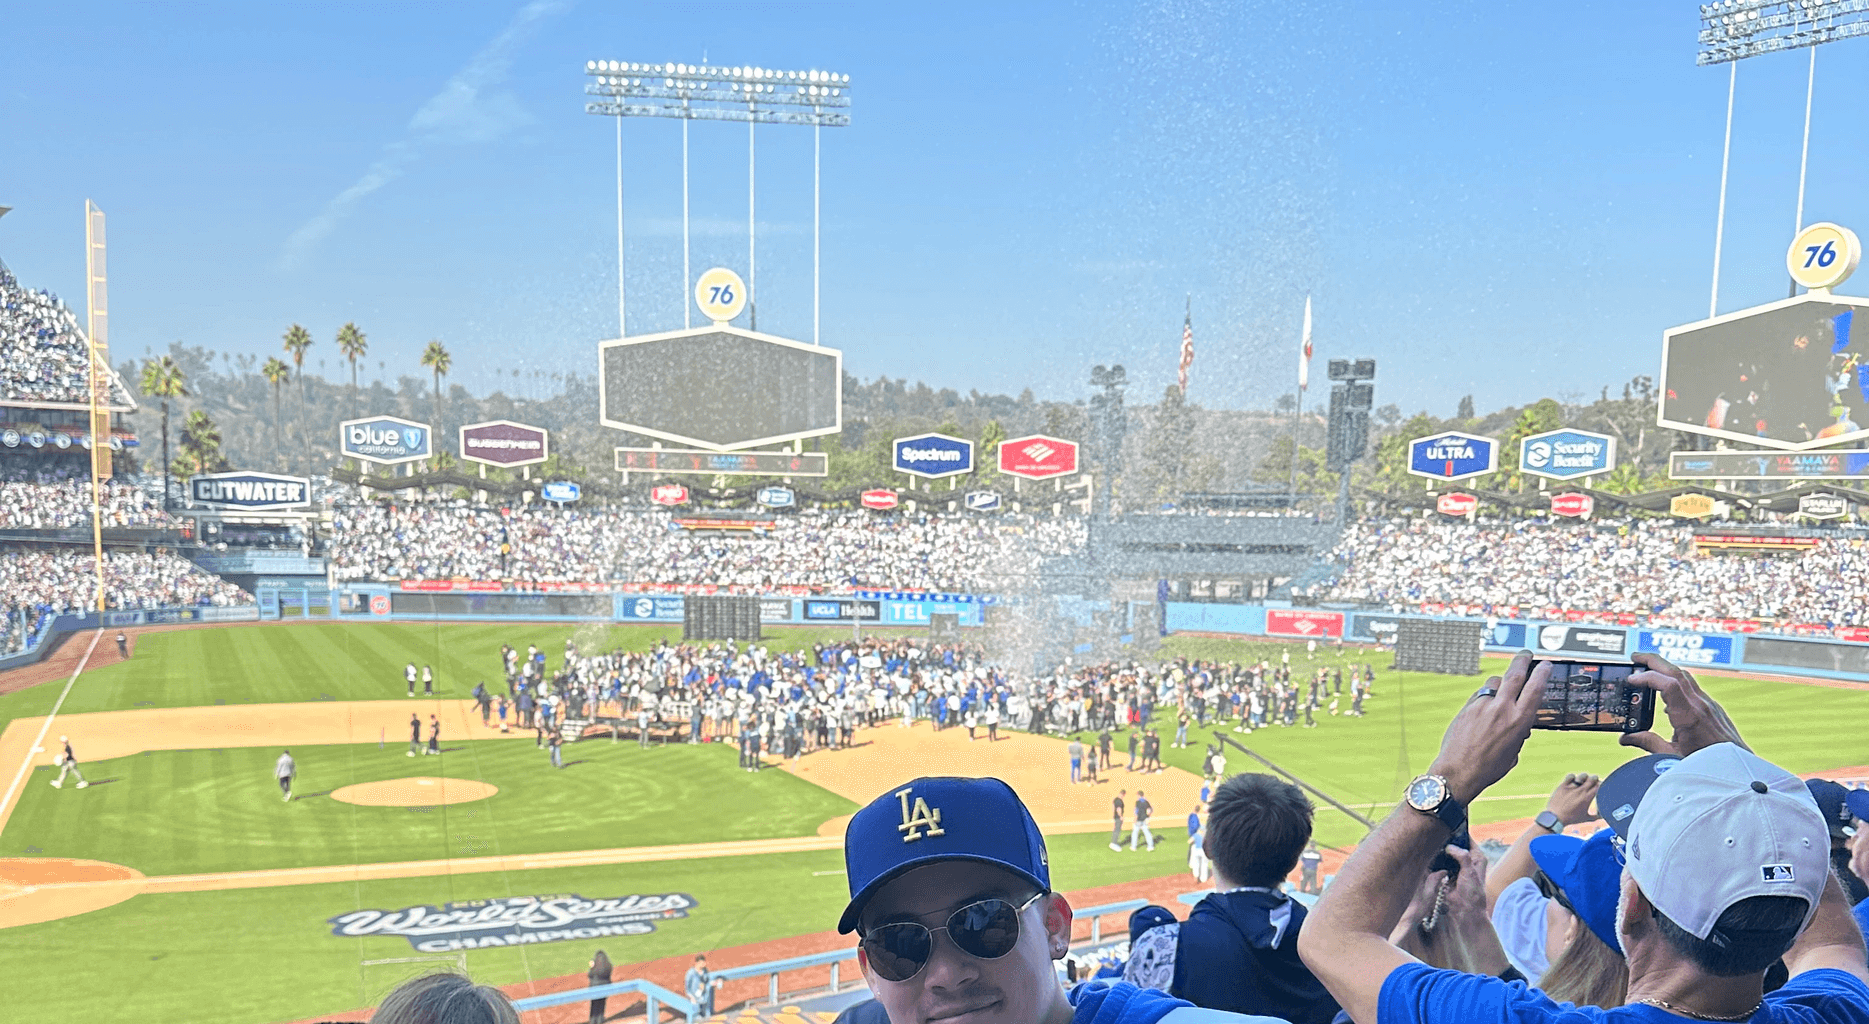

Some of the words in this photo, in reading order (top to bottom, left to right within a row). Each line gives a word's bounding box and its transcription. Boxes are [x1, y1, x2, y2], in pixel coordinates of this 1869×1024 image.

[1804, 241, 1837, 268] 76
[709, 285, 734, 305] 76
[350, 425, 399, 446] blue
[902, 447, 960, 463] Spectrum
[1426, 447, 1474, 459] ULTRA
[1553, 441, 1602, 456] Security
[1553, 455, 1594, 467] Benefit
[198, 481, 301, 501] CUTWATER
[812, 605, 836, 615] UCLA
[1652, 633, 1704, 649] TOYO
[1658, 648, 1717, 663] TIRES
[895, 788, 945, 842] LA
[338, 898, 546, 935] World
[518, 894, 690, 928] Series
[417, 922, 652, 951] CHAMPIONS
